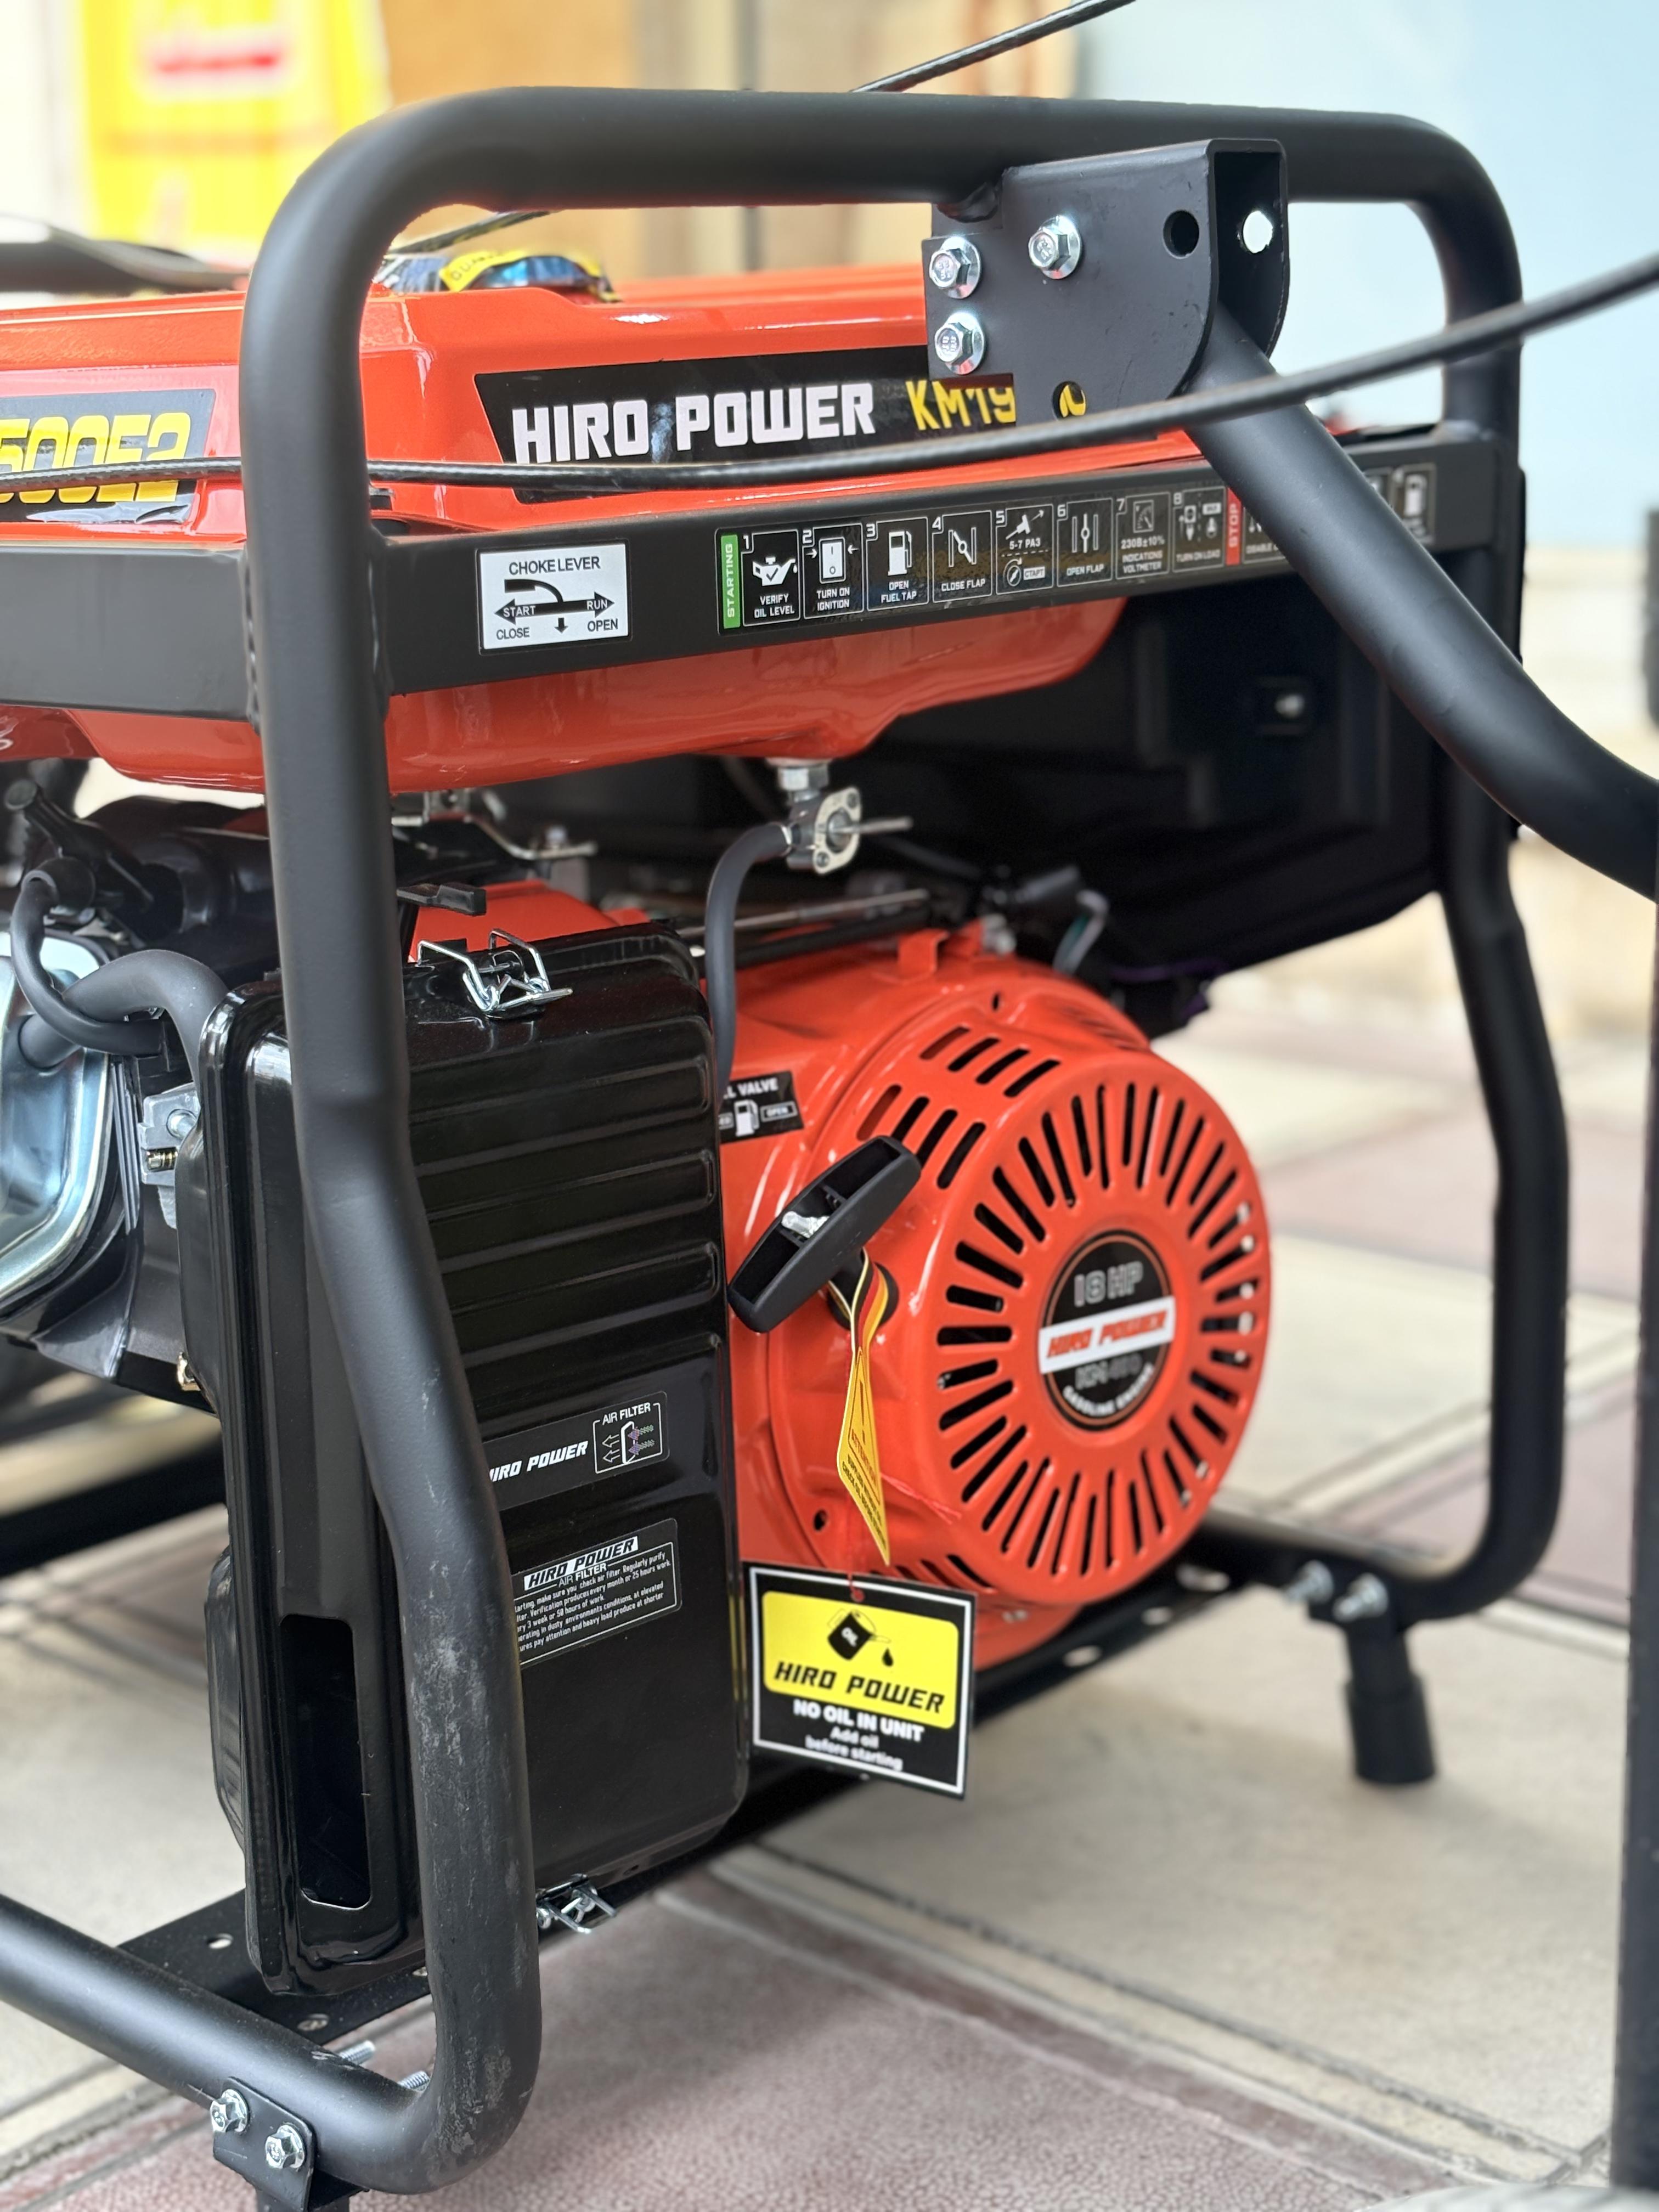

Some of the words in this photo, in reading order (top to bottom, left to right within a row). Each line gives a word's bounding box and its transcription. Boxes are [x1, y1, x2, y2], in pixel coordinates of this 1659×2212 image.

[512, 399, 649, 464] HIRO
[675, 383, 876, 451] POWER
[1116, 498, 1125, 511] 7
[1173, 492, 1182, 505] 8
[996, 510, 1005, 524] 5
[1057, 505, 1066, 517] 6
[932, 516, 941, 530] 4
[1228, 503, 1239, 548] STOP
[802, 530, 812, 544] 2
[866, 524, 876, 538] 3
[743, 535, 751, 549] 1
[1009, 539, 1023, 550] 5-7
[1122, 550, 1163, 563] INDICATIONS
[1176, 553, 1193, 562] TURN
[1204, 549, 1221, 559] LOAD
[509, 559, 556, 575] CHOKE
[558, 556, 600, 572] LEVER
[1066, 566, 1085, 576] OPEN
[1086, 564, 1104, 574] FLAP
[1123, 561, 1161, 573] VOLTMETER
[726, 543, 735, 618] STARTING
[889, 580, 909, 591] OPEN
[941, 581, 965, 591] CLOSE
[967, 578, 985, 589] FLAP
[760, 593, 789, 605] VERIFY
[817, 589, 838, 598] TURN
[839, 586, 850, 596] ON
[881, 592, 901, 603] FUEL
[902, 591, 917, 601] TAP
[503, 605, 536, 618] START
[586, 599, 608, 611] RUN
[754, 607, 767, 618] OIL
[769, 605, 794, 617] LEVEL
[817, 599, 850, 611] IGNITION
[587, 618, 618, 632] OPEN
[496, 627, 530, 640] CLOSE
[737, 1077, 778, 1096] VALVE
[1107, 1261, 1143, 1299] HP
[602, 1412, 618, 1425] AIR
[619, 1402, 651, 1420] FILTER
[527, 1441, 589, 1472] POWER
[528, 1563, 568, 1588] HIRO
[573, 1538, 635, 1572] POWER
[537, 1594, 551, 1604] make
[553, 1590, 565, 1599] sure
[567, 1585, 577, 1595] you
[580, 1577, 596, 1589] check
[623, 1558, 647, 1573] Regularly
[649, 1551, 665, 1565] purify
[558, 1575, 573, 1588] AIR
[575, 1563, 607, 1581] FILTER
[530, 1601, 562, 1617] Verification
[564, 1590, 589, 1606] produces
[590, 1585, 606, 1595] every
[607, 1577, 624, 1588] month
[632, 1570, 639, 1579] 25
[640, 1566, 655, 1576] hours
[533, 1615, 548, 1626] week
[565, 1604, 580, 1614] hours
[582, 1599, 588, 1607] of
[548, 1621, 563, 1630] dusty
[566, 1606, 602, 1624] environments
[641, 1581, 663, 1596] elevated
[534, 1638, 544, 1648] pay
[546, 1628, 571, 1641] attention
[572, 1622, 582, 1632] and
[583, 1617, 600, 1628] heavy
[601, 1610, 612, 1621] load
[614, 1604, 635, 1618] produce
[637, 1599, 642, 1607] at
[644, 1593, 663, 1605] shorter
[841, 1627, 859, 1647] OIL
[774, 1661, 837, 1690] HIRO
[845, 1675, 945, 1713] POWER
[793, 1699, 821, 1718] NO
[823, 1705, 855, 1726] OIL
[857, 1712, 877, 1731] IN
[880, 1717, 925, 1742] UNIT
[830, 1726, 859, 1743] Add
[861, 1734, 879, 1748] oil
[805, 1735, 849, 1758] before
[850, 1743, 903, 1772] starting
